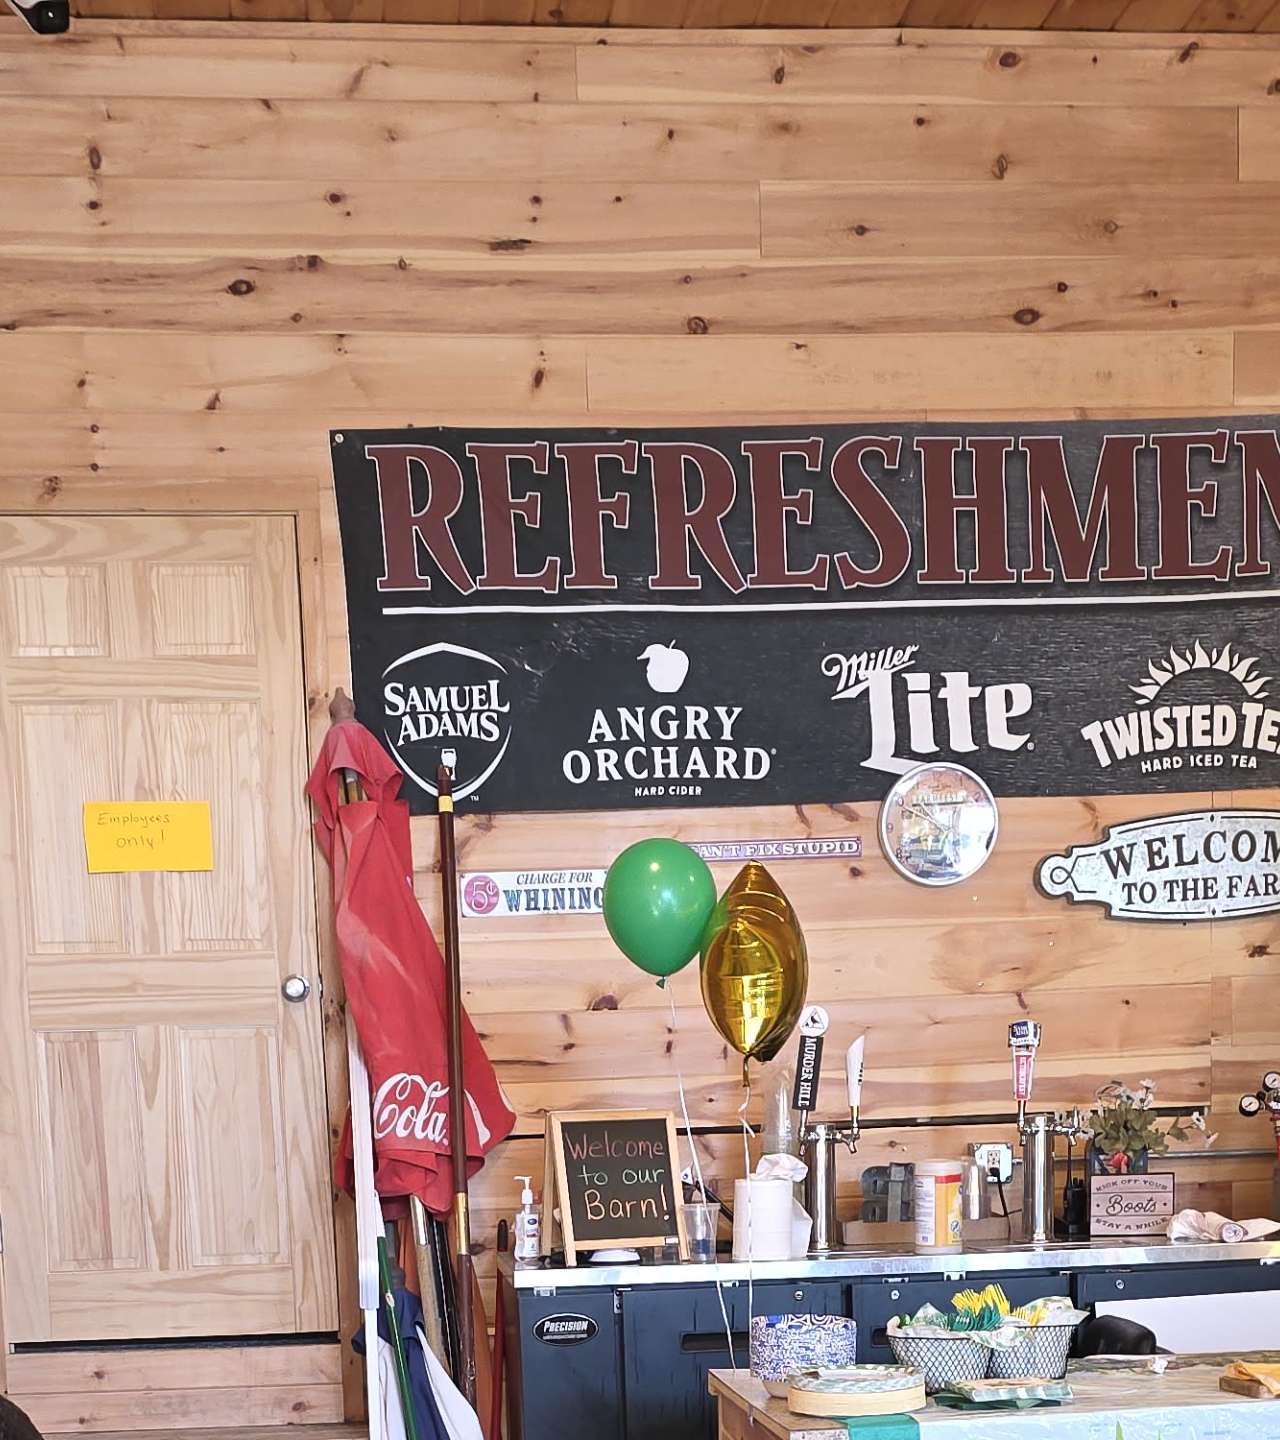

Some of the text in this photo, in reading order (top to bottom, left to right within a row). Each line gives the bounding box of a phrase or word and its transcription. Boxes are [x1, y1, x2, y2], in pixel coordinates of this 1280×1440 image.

[821, 645, 919, 692] Miller
[384, 680, 510, 715] SAMUEL
[397, 711, 500, 746] ADAMS
[588, 705, 743, 743] ANGRY
[860, 671, 1033, 776] Lite
[1081, 704, 1237, 768] TWISTED
[563, 746, 771, 784] ORCHARD
[1141, 754, 1258, 773] HARD ICED TEA
[635, 786, 703, 797] HARD CIDER
[97, 812, 170, 828] Employees
[745, 843, 780, 856] FIX
[782, 841, 858, 855] STUPID
[517, 872, 593, 885] CHARGE FOR
[1122, 881, 1157, 906] TO
[1163, 877, 1219, 902] THE
[800, 1037, 817, 1080] MURDER
[373, 1073, 448, 1142] Cola
[564, 1131, 664, 1160] Welcome
[577, 1164, 665, 1186] to our
[585, 1184, 670, 1222] Barn!
[1105, 1194, 1157, 1216] Boots
[543, 1320, 589, 1333] PRECISION
